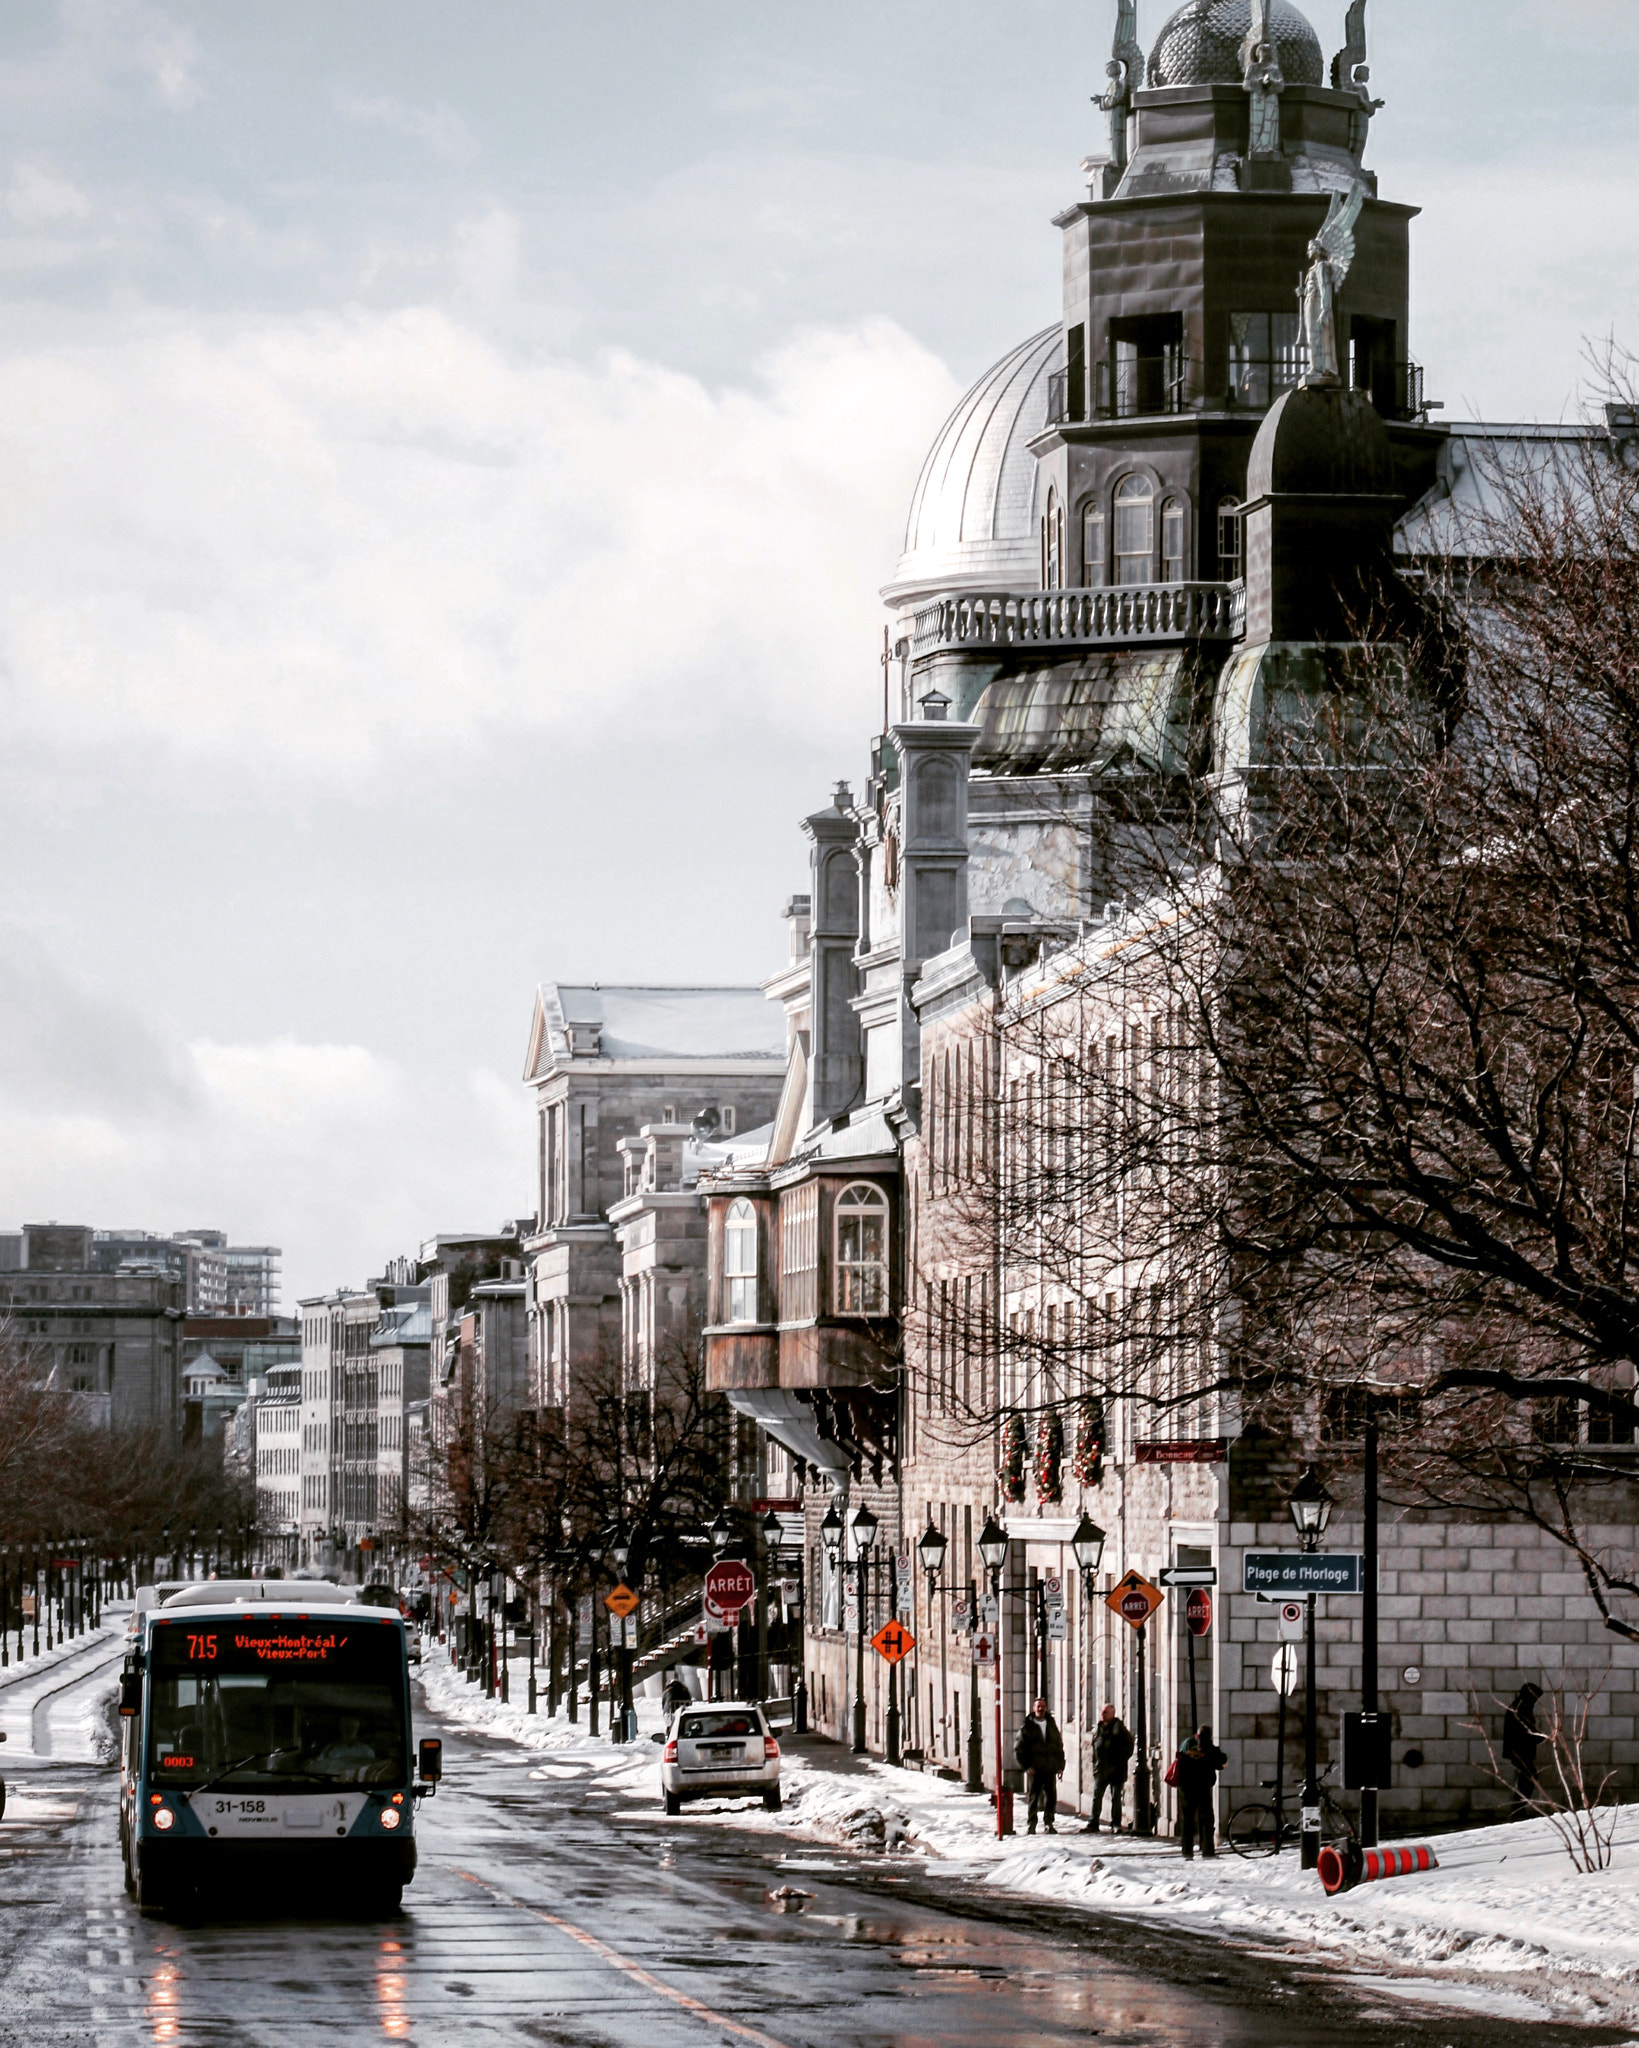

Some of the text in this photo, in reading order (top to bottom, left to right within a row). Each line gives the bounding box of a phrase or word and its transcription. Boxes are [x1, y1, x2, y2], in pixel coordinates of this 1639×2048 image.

[1247, 1566, 1349, 1584] Plage de l'Horloge
[708, 1575, 751, 1592] ARRÊT
[187, 1635, 217, 1659] 715
[235, 1634, 336, 1648] Vieux-Montréal
[257, 1648, 327, 1659] Vieux-Port
[164, 1757, 194, 1767] 0003
[215, 1801, 266, 1813] 31-158
